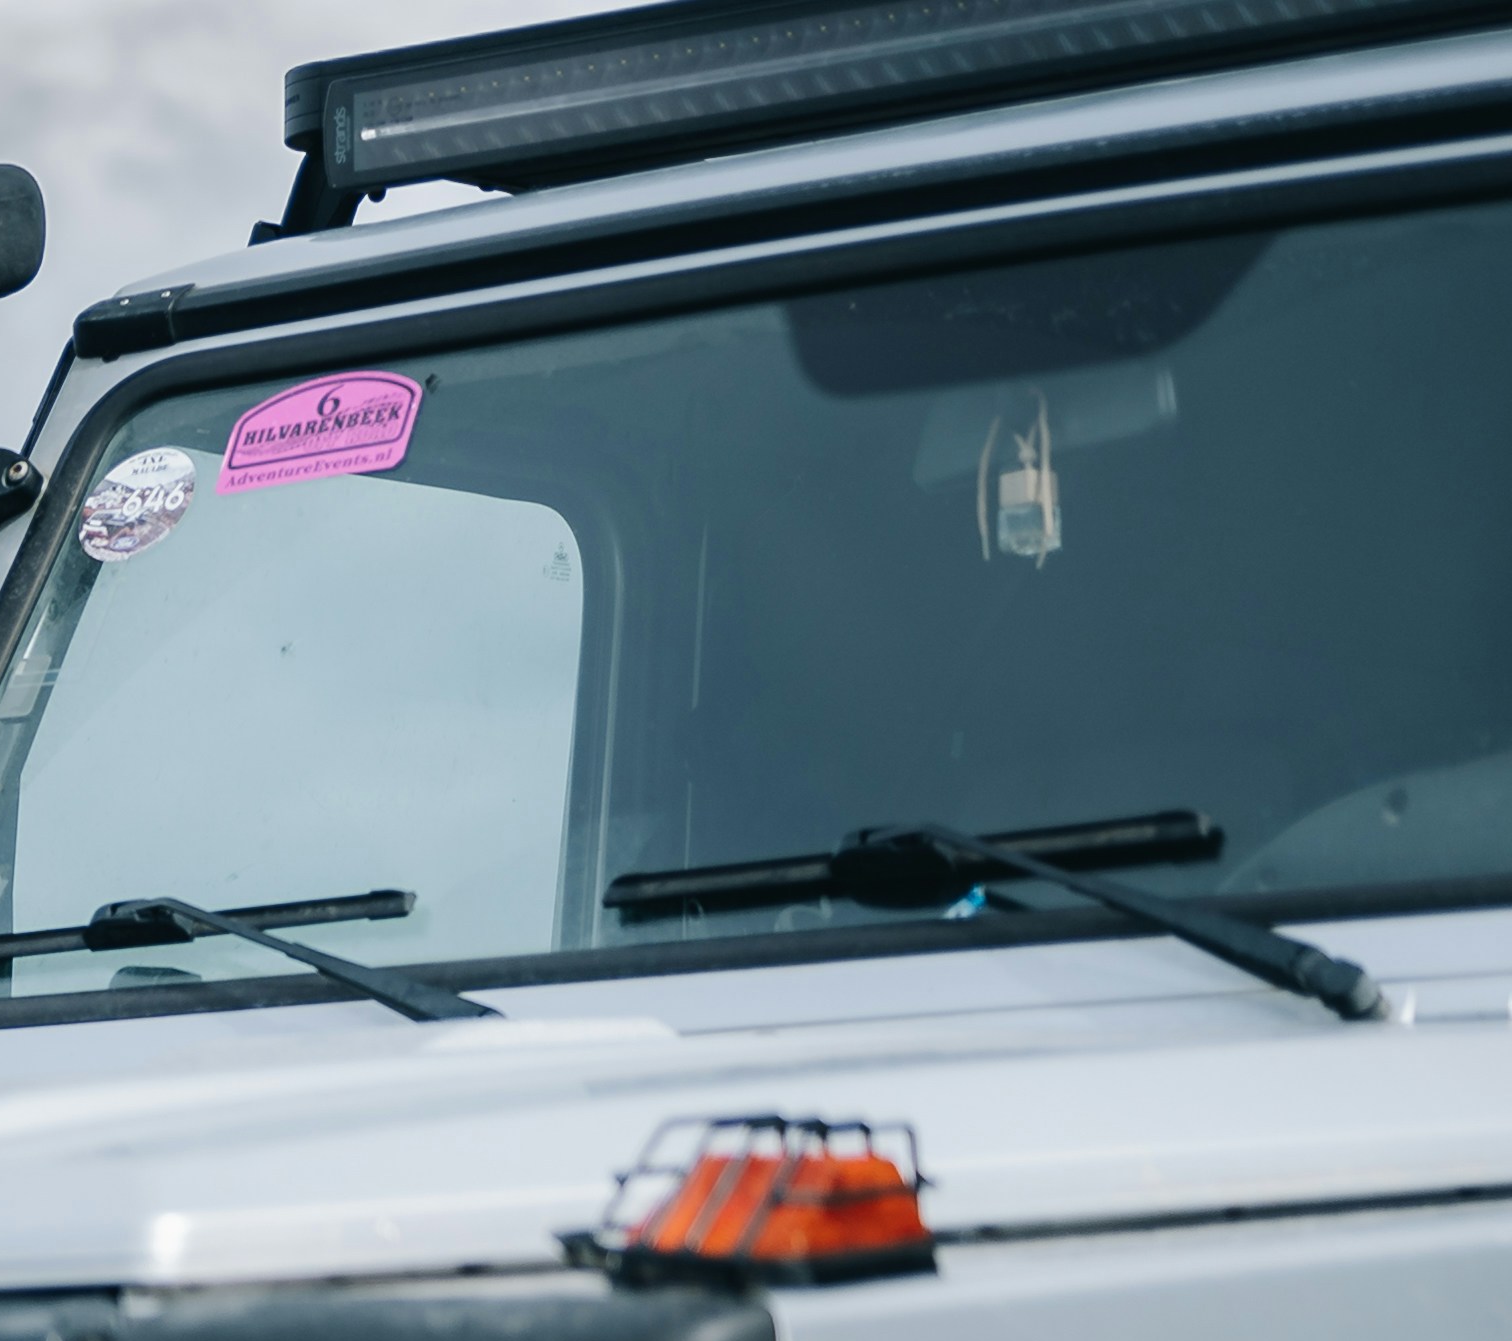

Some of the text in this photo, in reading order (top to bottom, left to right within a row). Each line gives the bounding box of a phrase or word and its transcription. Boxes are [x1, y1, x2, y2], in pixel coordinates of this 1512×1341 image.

[334, 105, 346, 165] strands
[317, 384, 345, 418] 6
[242, 403, 402, 447] HILVARENBEEK
[225, 449, 392, 489] AdventureEvents.nl
